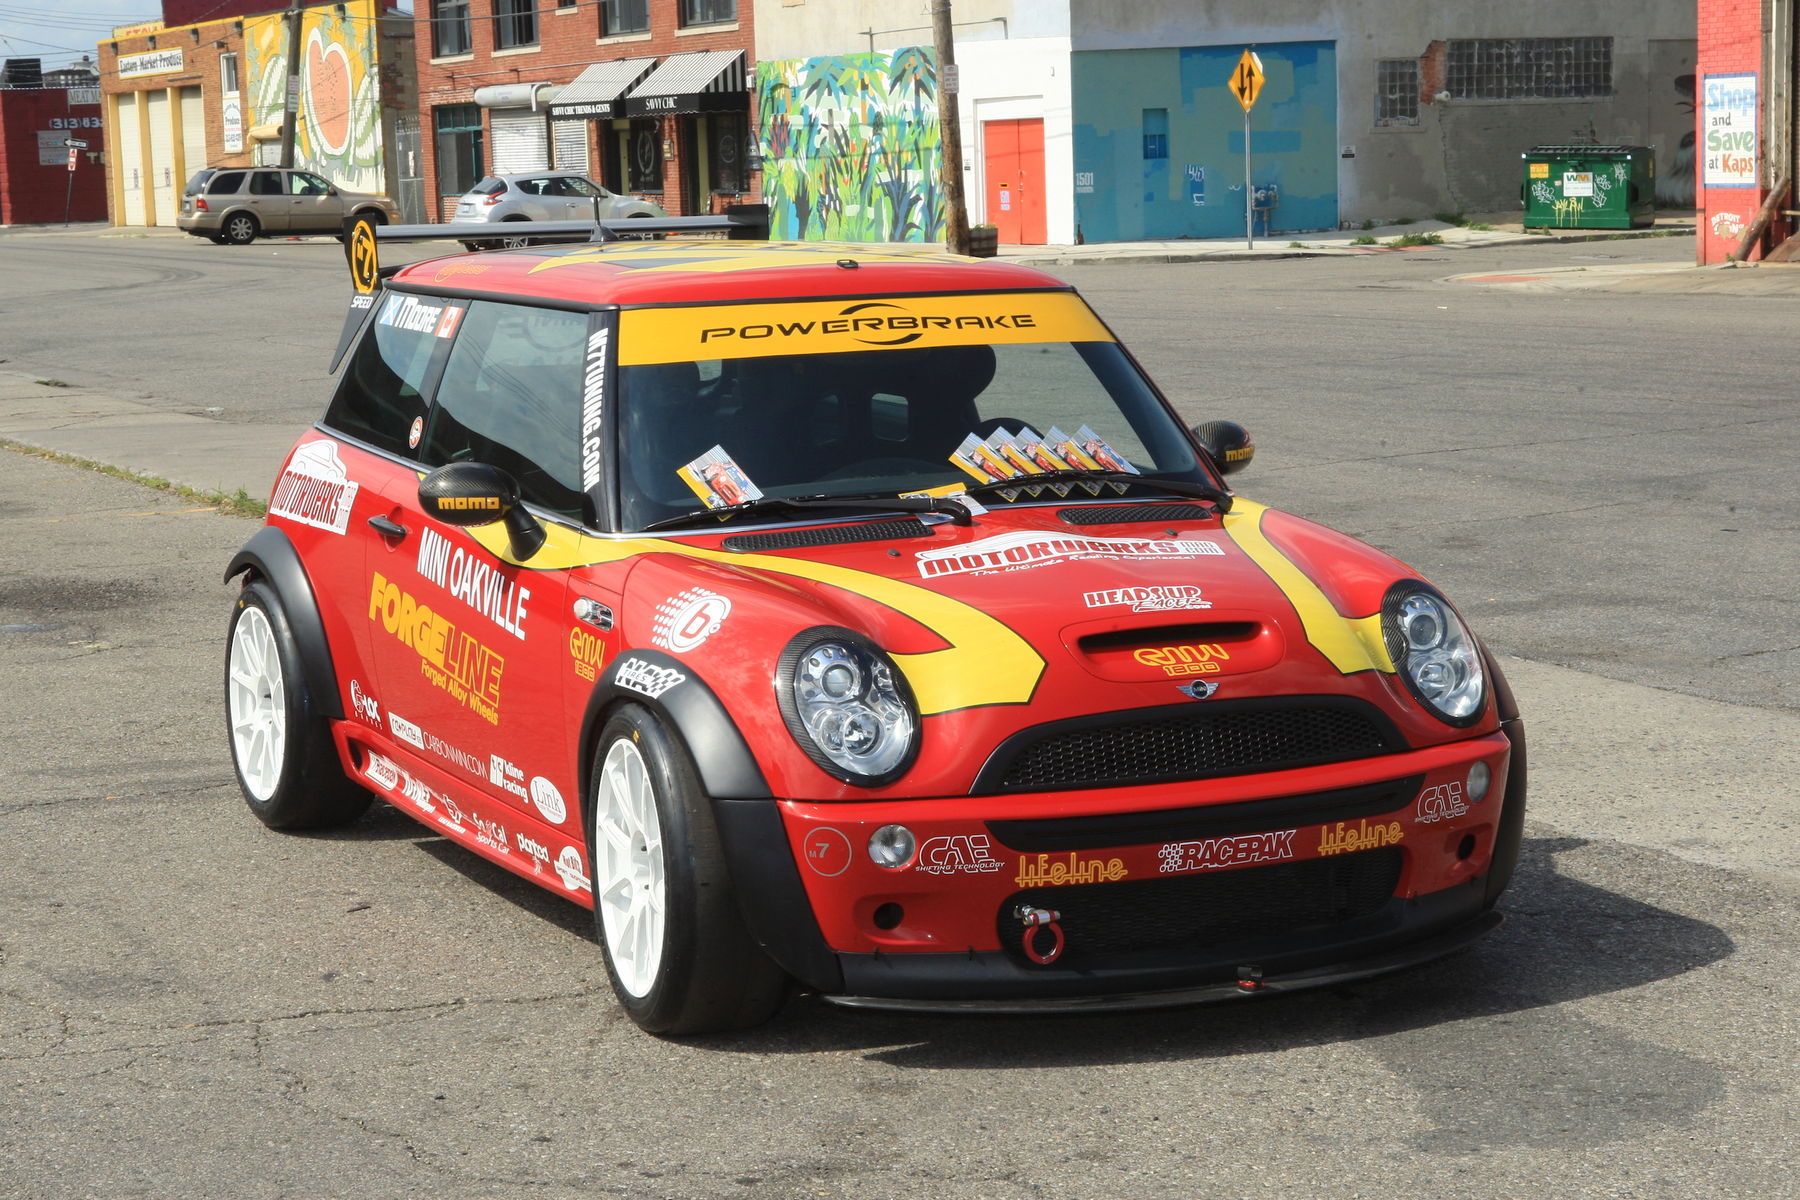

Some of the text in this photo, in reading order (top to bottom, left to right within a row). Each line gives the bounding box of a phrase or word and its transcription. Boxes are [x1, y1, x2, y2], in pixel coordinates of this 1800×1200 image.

[120, 53, 182, 73] Eastern Market Produce
[552, 107, 564, 116] SAVVY
[564, 106, 575, 115] CHIC
[575, 105, 592, 115] TRENDS
[596, 104, 610, 113] GENTS
[645, 97, 678, 110] SAVVY CHIC
[1707, 83, 1755, 116] Shop
[1712, 112, 1731, 126] and
[1707, 129, 1754, 152] Save
[1709, 153, 1753, 178] at Kaps
[1075, 172, 1094, 186] 1501
[1566, 174, 1589, 182] WM
[351, 296, 374, 309] SPEED
[700, 314, 1036, 343] POWERBRAKE
[438, 497, 499, 510] momo
[923, 540, 1180, 576] MOTORWERKS
[417, 526, 531, 641] MINI OAKVILLE
[969, 569, 999, 577] The
[369, 571, 504, 709] FORGELINE
[623, 669, 648, 682] TIRES
[421, 658, 499, 726] Forged Alloy Wheels
[503, 779, 529, 804] racing
[533, 780, 562, 814] Link
[476, 831, 510, 855] Sports Car
[1178, 829, 1297, 871] RACEPAK
[1318, 819, 1404, 857] lifeline
[915, 861, 1006, 872] SHIFTING TECHNOLOGY
[1014, 852, 1128, 888] lifeline
